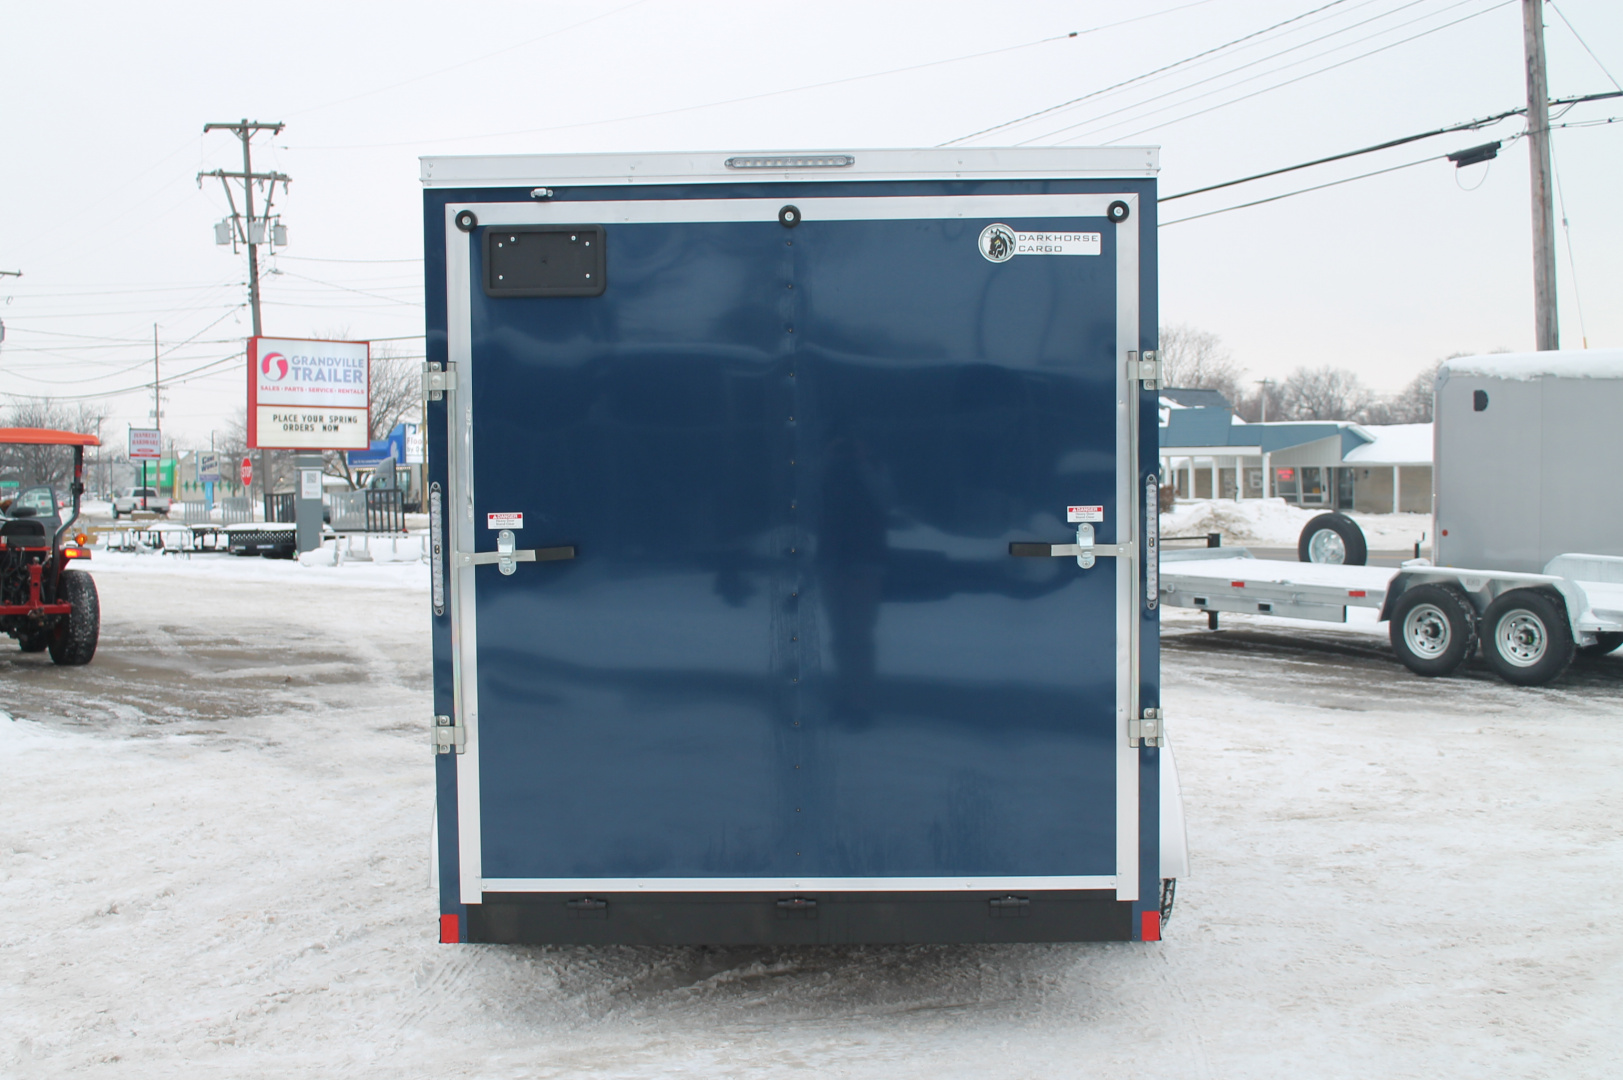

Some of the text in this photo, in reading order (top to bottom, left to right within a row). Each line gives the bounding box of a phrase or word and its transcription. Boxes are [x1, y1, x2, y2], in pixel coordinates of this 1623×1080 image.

[1018, 234, 1099, 242] DARKHORSE
[1018, 245, 1063, 253] CARGO
[291, 355, 365, 368] GRANDVILLE
[291, 367, 364, 384] TRAILER
[273, 414, 358, 424] PLACE YOUR SPRING
[283, 424, 339, 432] ORDERS NOW
[241, 465, 252, 478] STOP
